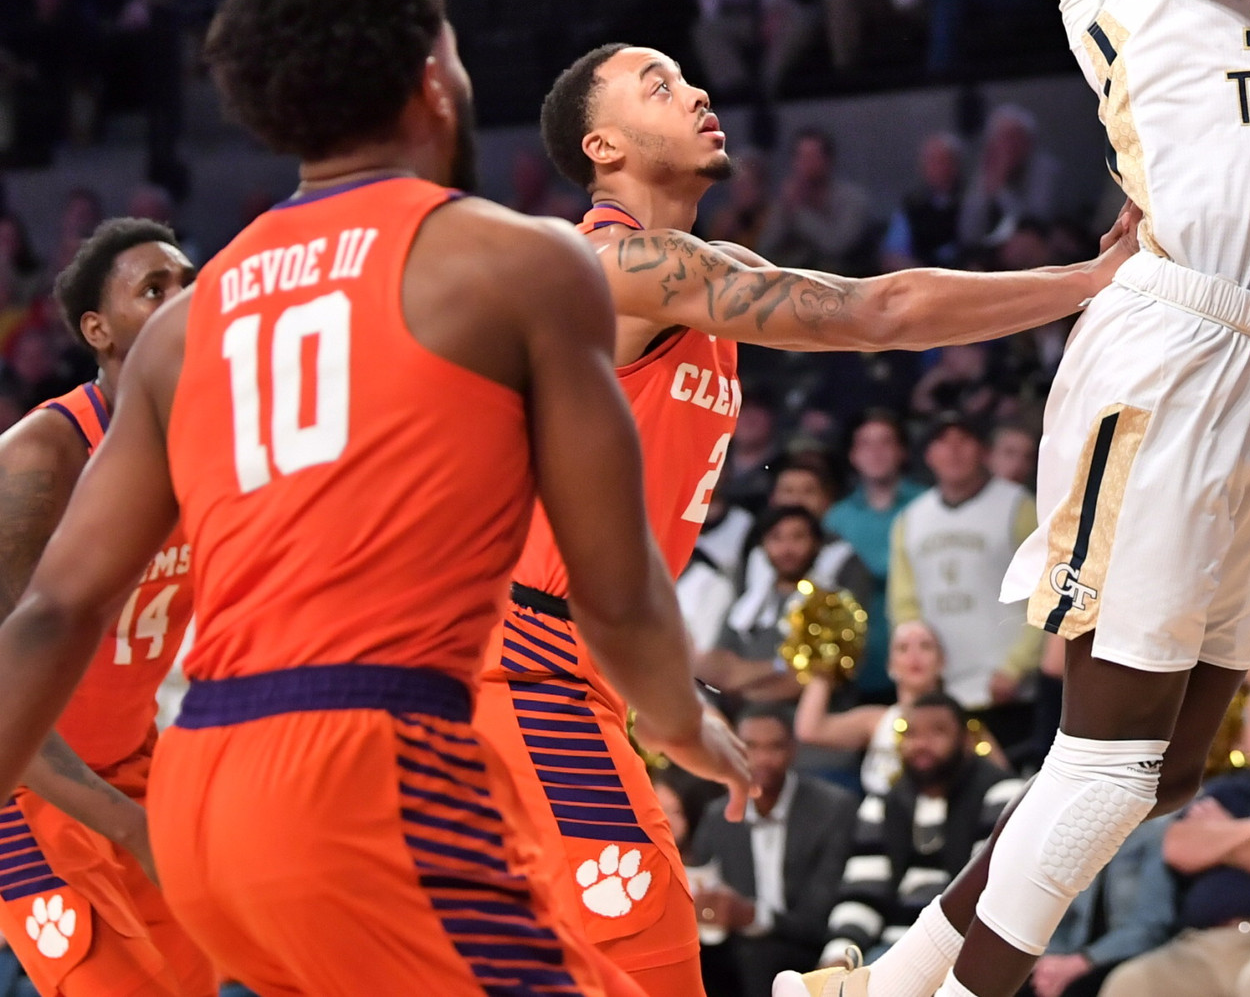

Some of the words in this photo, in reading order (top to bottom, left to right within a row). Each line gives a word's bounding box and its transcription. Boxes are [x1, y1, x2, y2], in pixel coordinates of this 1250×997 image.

[220, 237, 328, 314] DEVOE
[328, 227, 379, 280] III
[221, 289, 351, 494] 10
[113, 584, 179, 665] 14
[1050, 562, 1097, 610] GT
